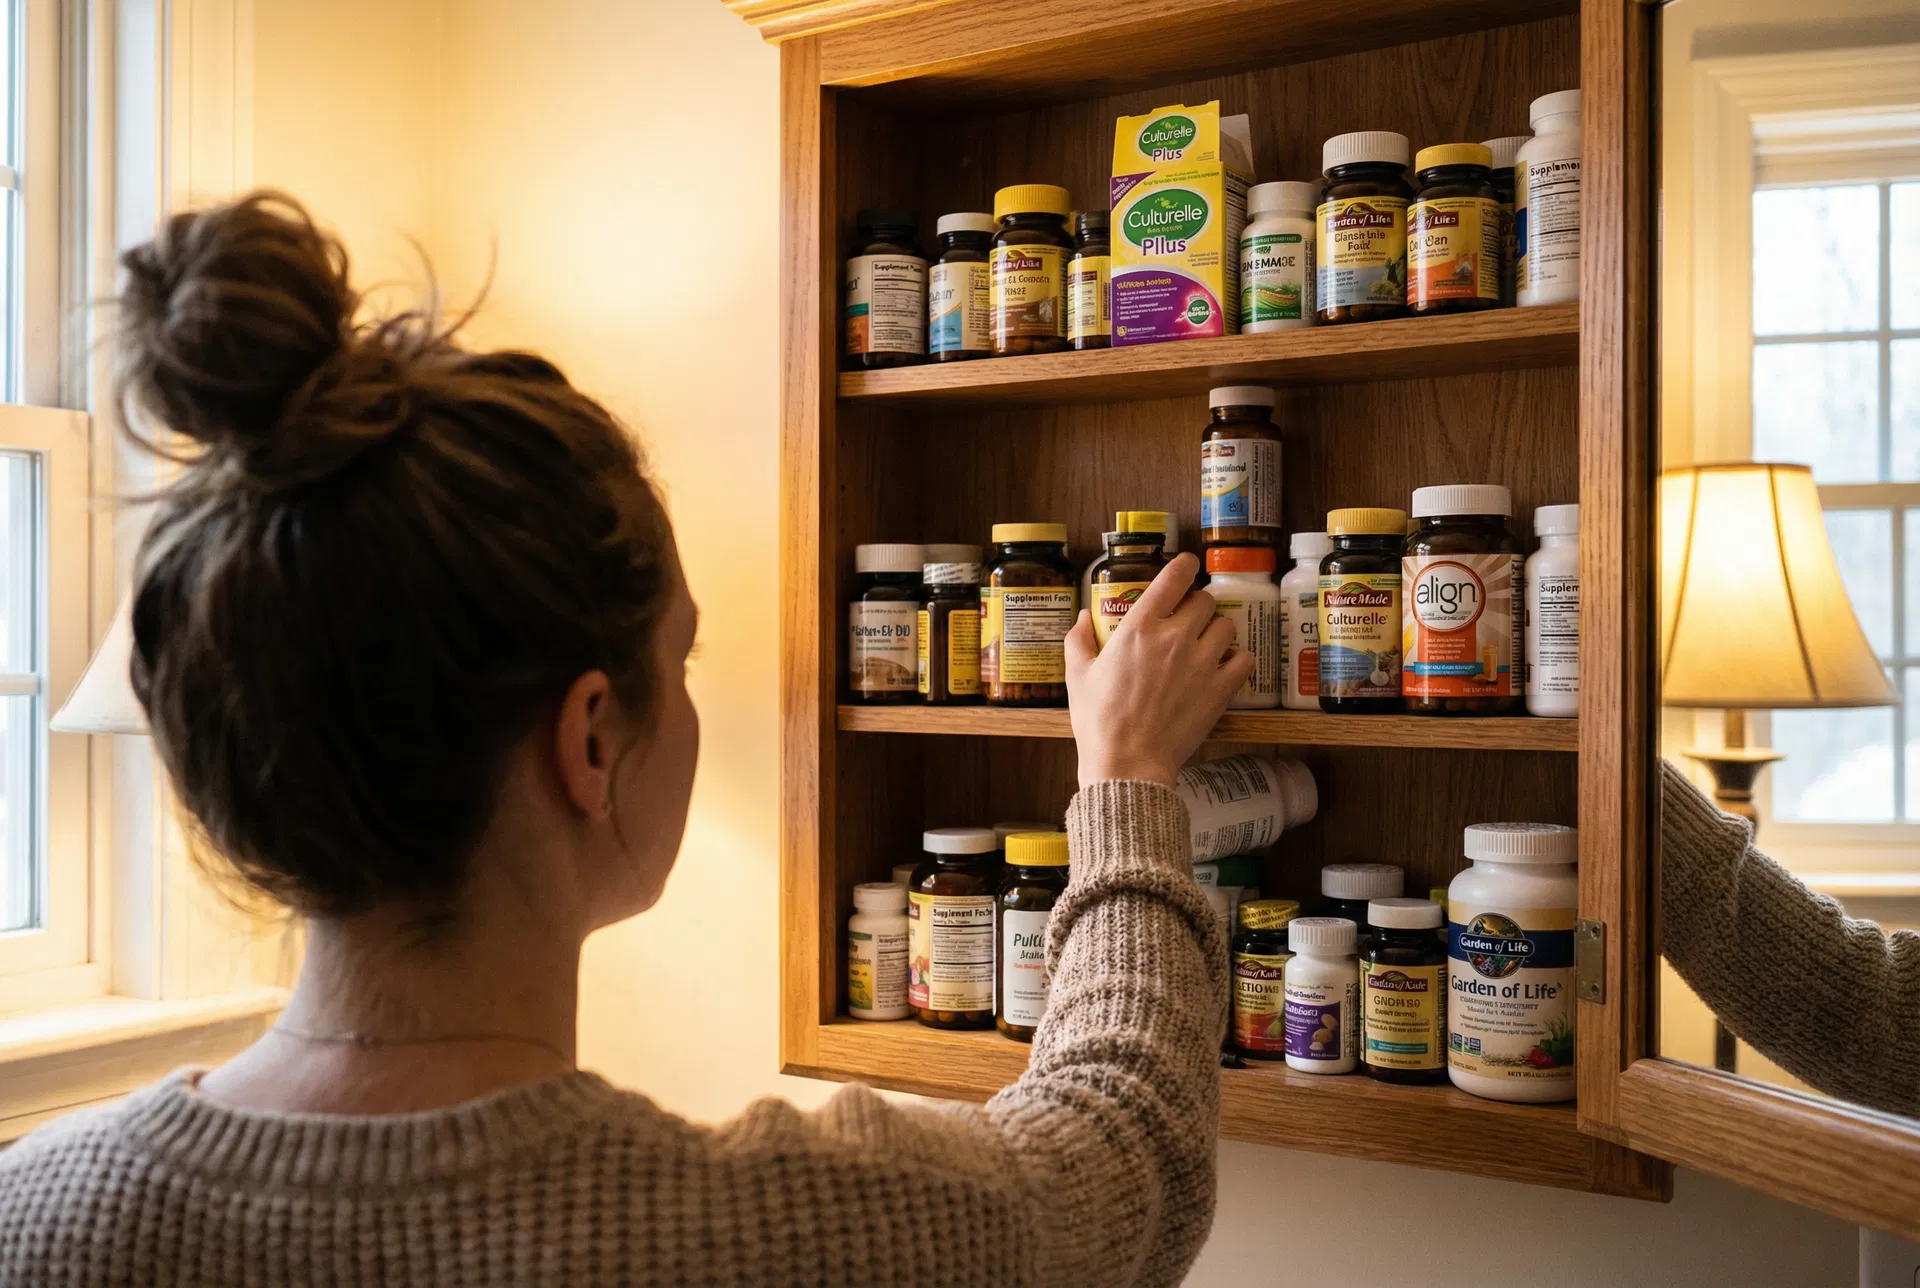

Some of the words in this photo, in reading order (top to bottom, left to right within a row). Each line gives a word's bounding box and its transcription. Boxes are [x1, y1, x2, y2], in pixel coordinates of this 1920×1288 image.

[1141, 125, 1194, 145] Culturelle
[1153, 147, 1183, 162] Plus
[1128, 205, 1203, 228] Culturelle
[1327, 612, 1387, 625] Culturelle
[1461, 937, 1492, 950] Garden
[1495, 941, 1506, 954] of
[1508, 942, 1529, 953] Life
[1451, 975, 1497, 996] Garden
[1502, 982, 1520, 998] of
[1525, 983, 1557, 999] Life
